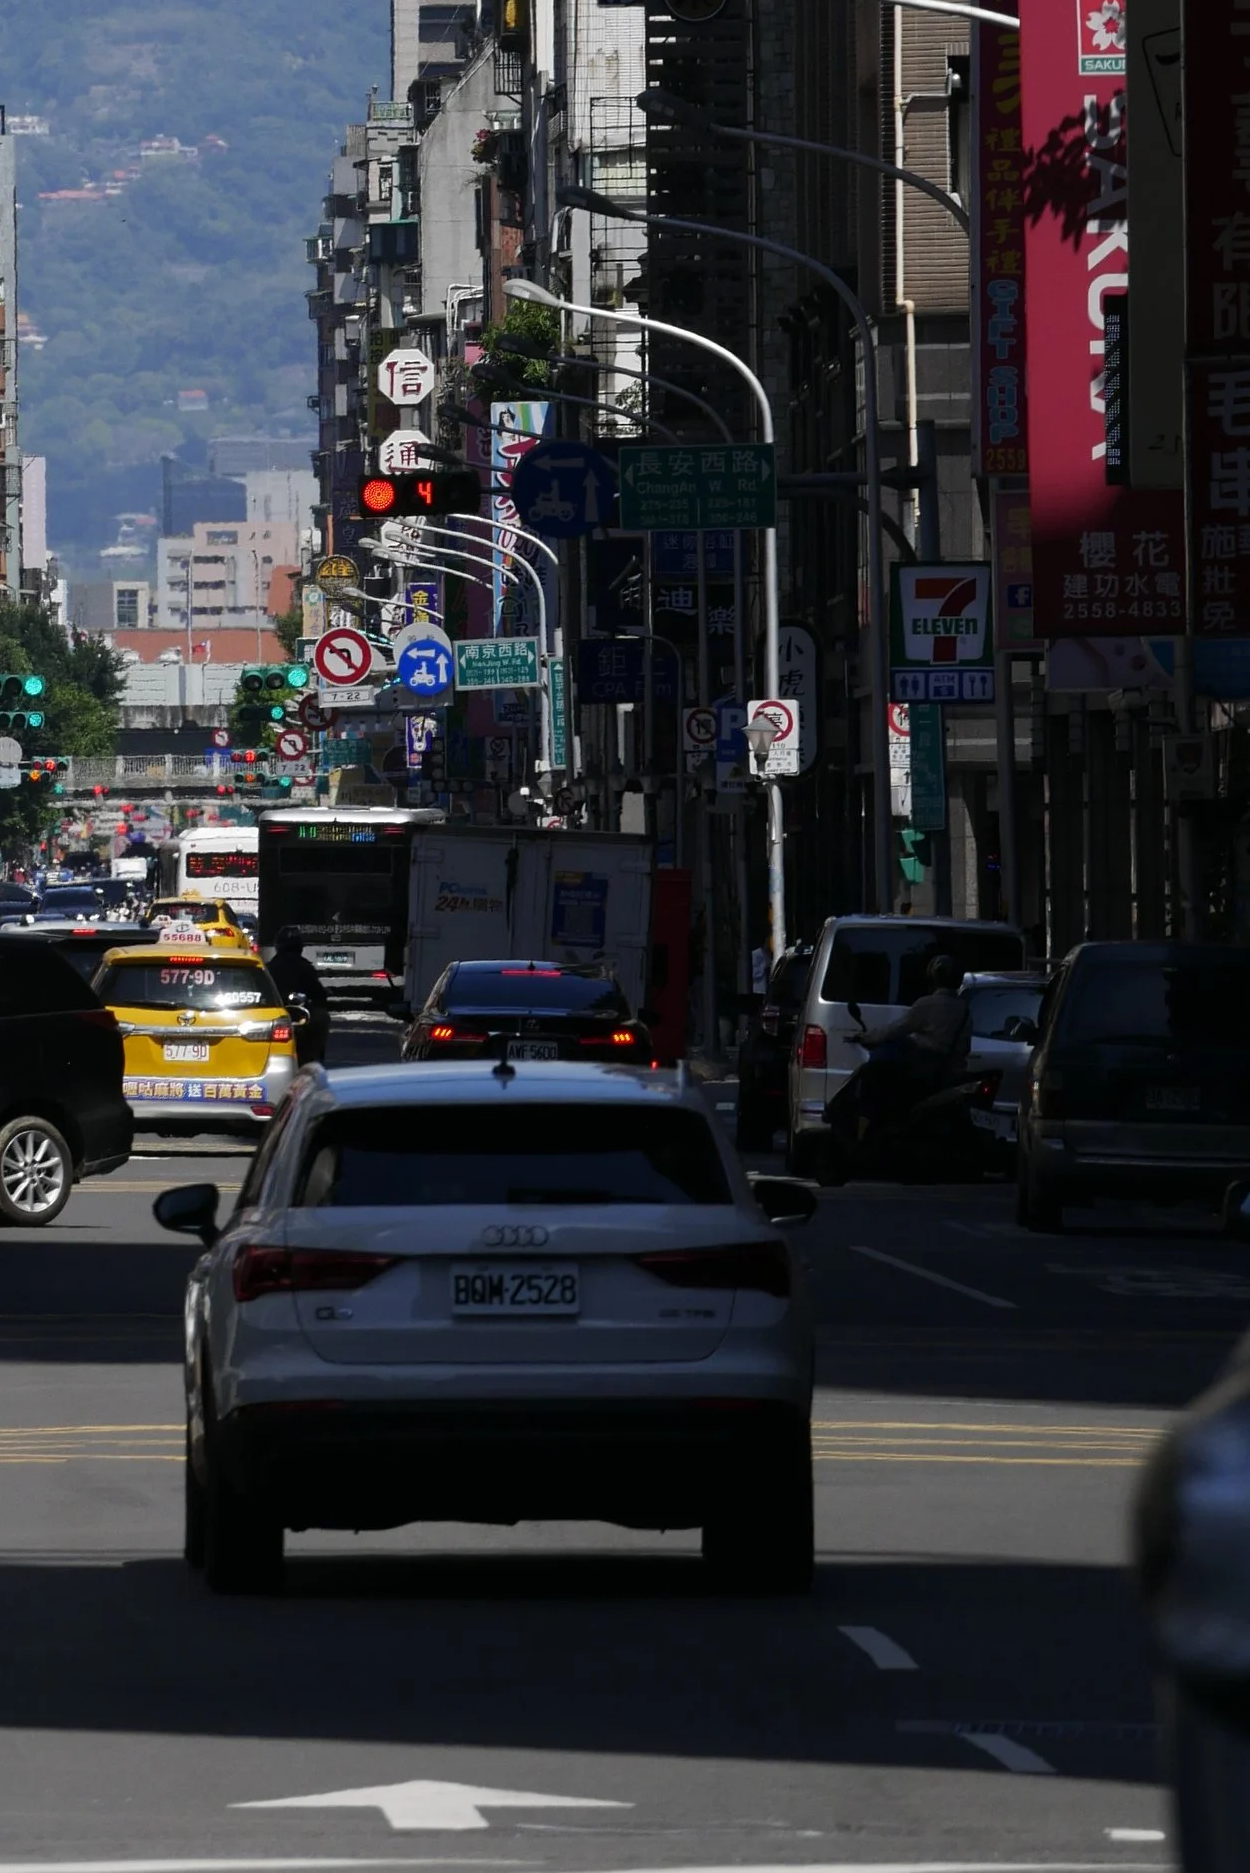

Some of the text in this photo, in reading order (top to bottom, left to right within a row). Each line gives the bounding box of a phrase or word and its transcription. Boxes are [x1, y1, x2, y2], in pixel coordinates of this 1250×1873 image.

[636, 449, 759, 476] 長安西路
[1079, 530, 1172, 568] 櫻花
[1063, 570, 1181, 599] 建功水電
[1062, 600, 1182, 619] 2558-4833
[465, 642, 528, 659] 南京西路
[163, 933, 202, 942] 55688
[160, 969, 215, 985] 577-9D
[454, 1274, 577, 1305] BQM-2528
